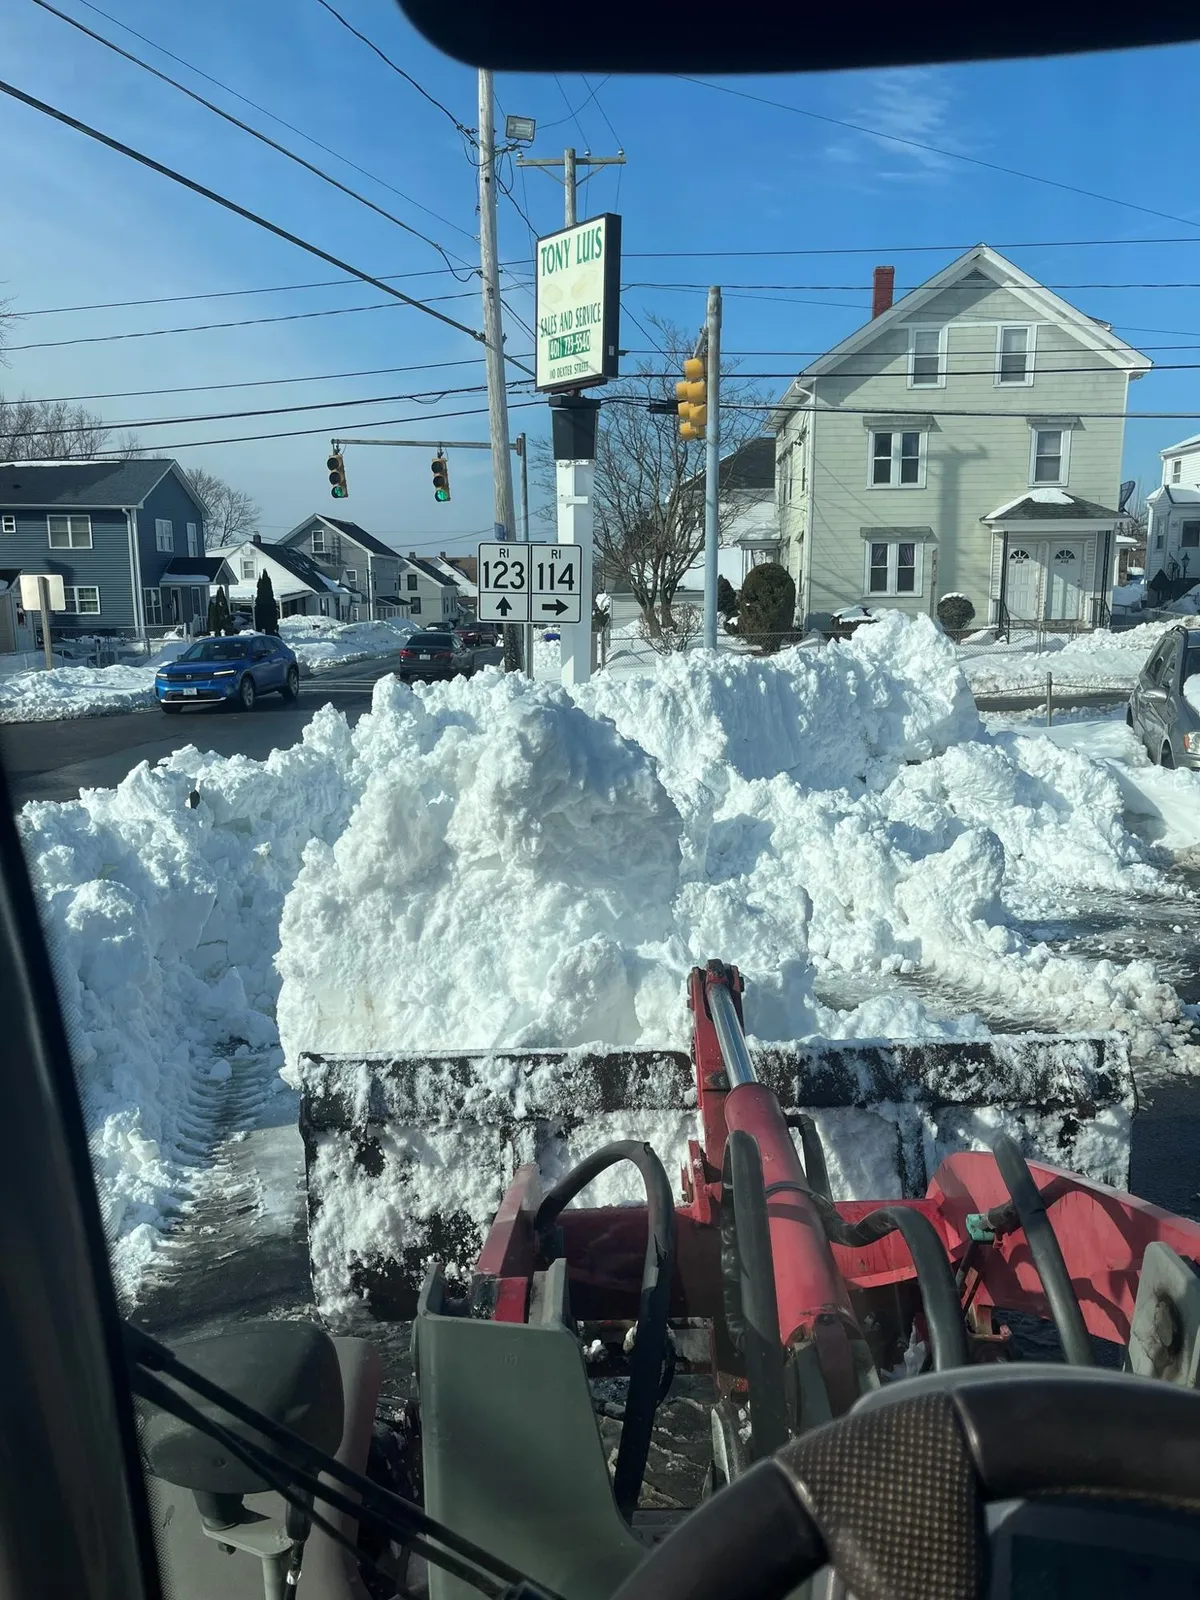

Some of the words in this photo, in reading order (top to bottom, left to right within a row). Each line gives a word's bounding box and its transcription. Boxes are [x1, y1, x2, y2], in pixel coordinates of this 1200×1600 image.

[541, 238, 570, 276] TONY
[577, 226, 602, 265] LUIS
[540, 314, 557, 337] SALES
[560, 310, 573, 332] AND
[575, 303, 601, 328] SERVICE
[557, 365, 572, 377] DEXTER
[573, 361, 588, 374] STREET
[499, 548, 509, 558] RI
[551, 549, 561, 559] RI
[483, 560, 525, 589] 123
[537, 562, 574, 591] 114
